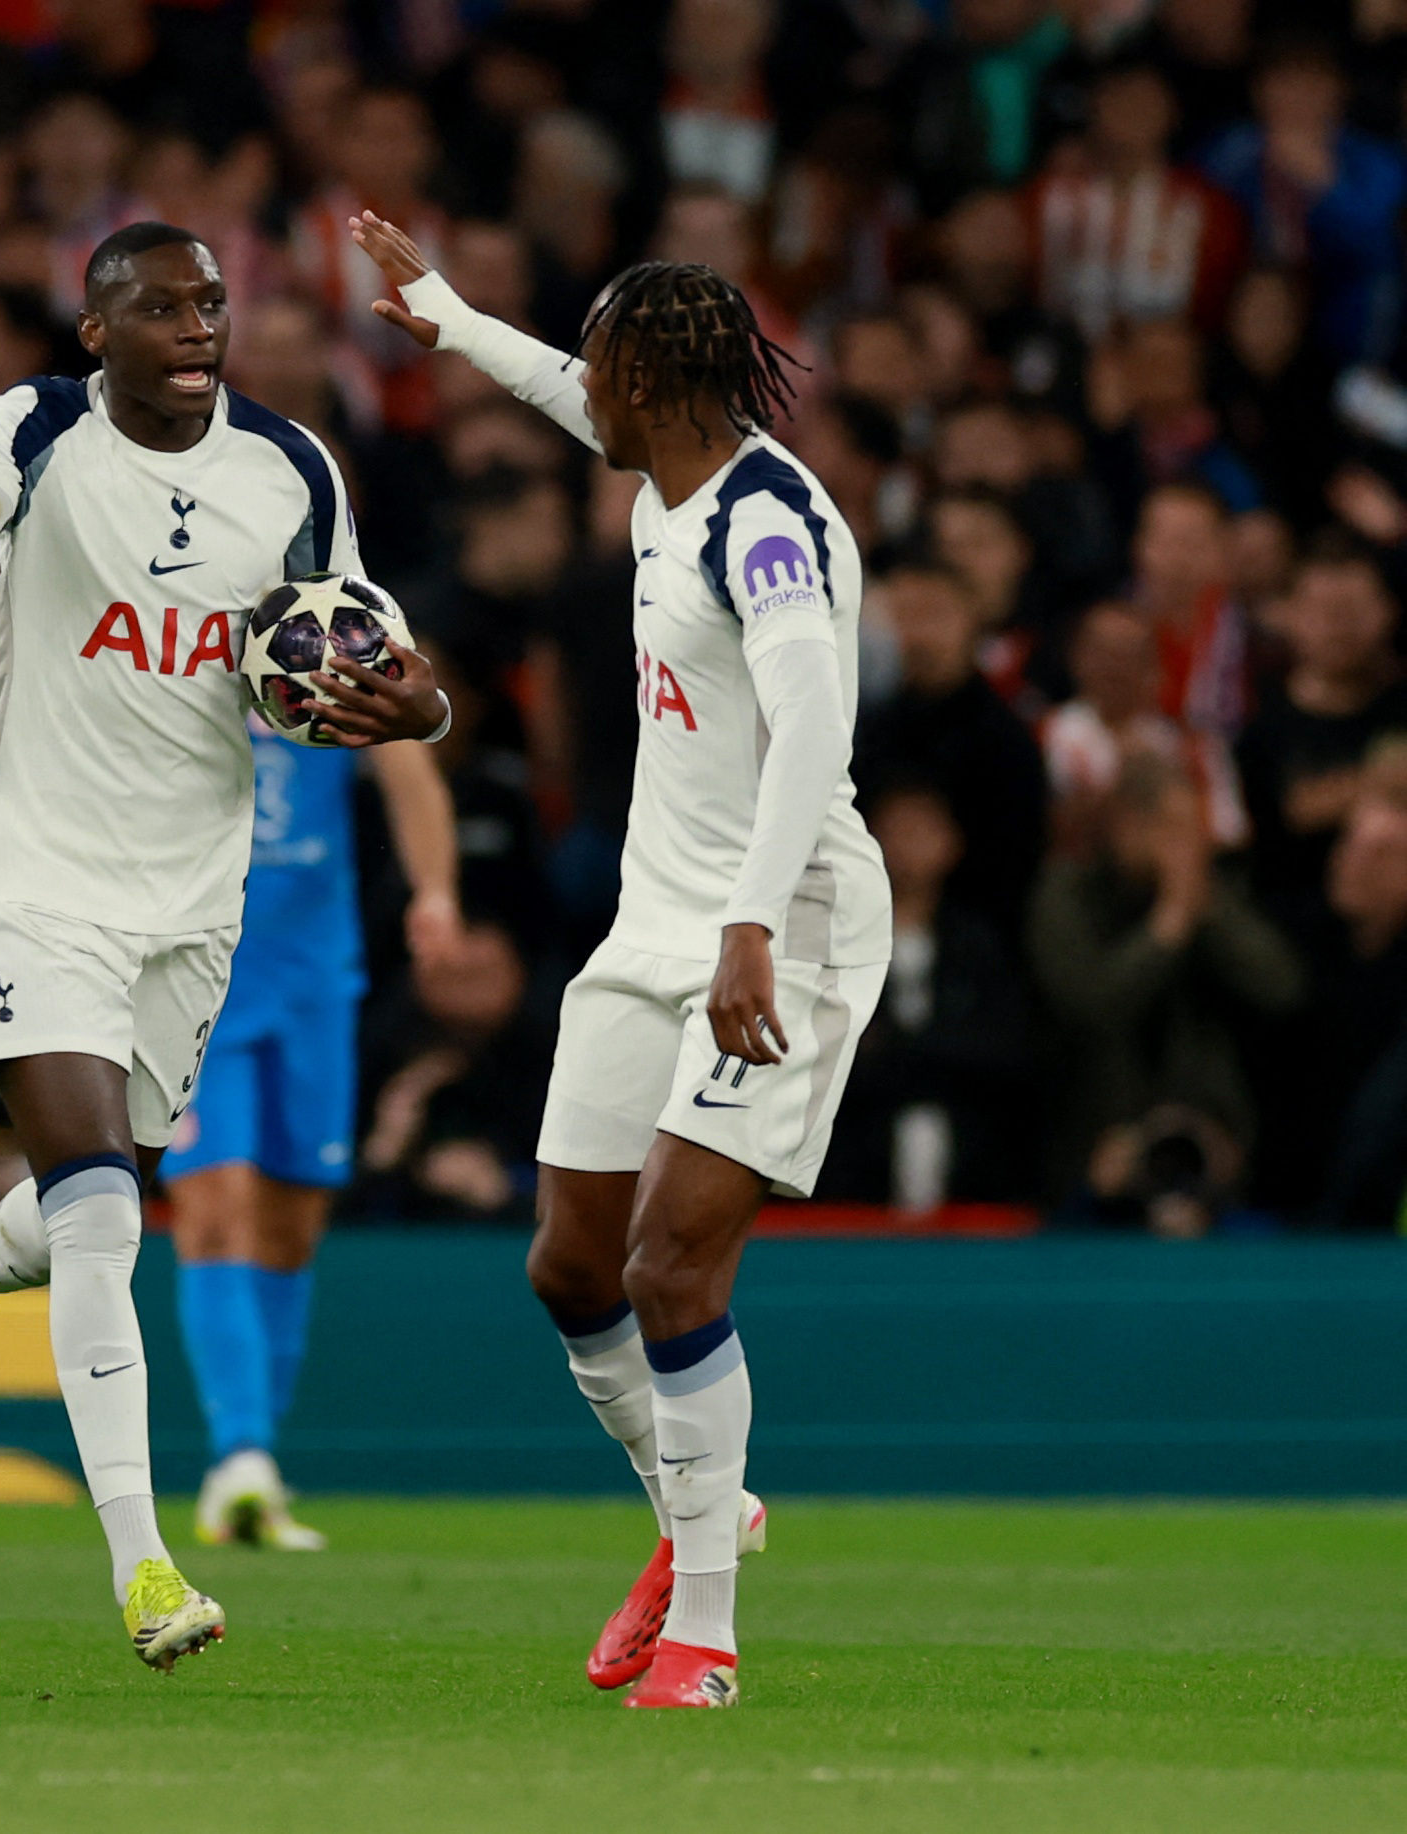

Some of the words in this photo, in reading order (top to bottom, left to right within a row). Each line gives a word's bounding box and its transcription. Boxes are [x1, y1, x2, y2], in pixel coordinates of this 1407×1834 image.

[79, 601, 235, 677] AIA
[752, 590, 817, 619] kraken
[638, 645, 698, 732] IA
[182, 1010, 219, 1094] 3
